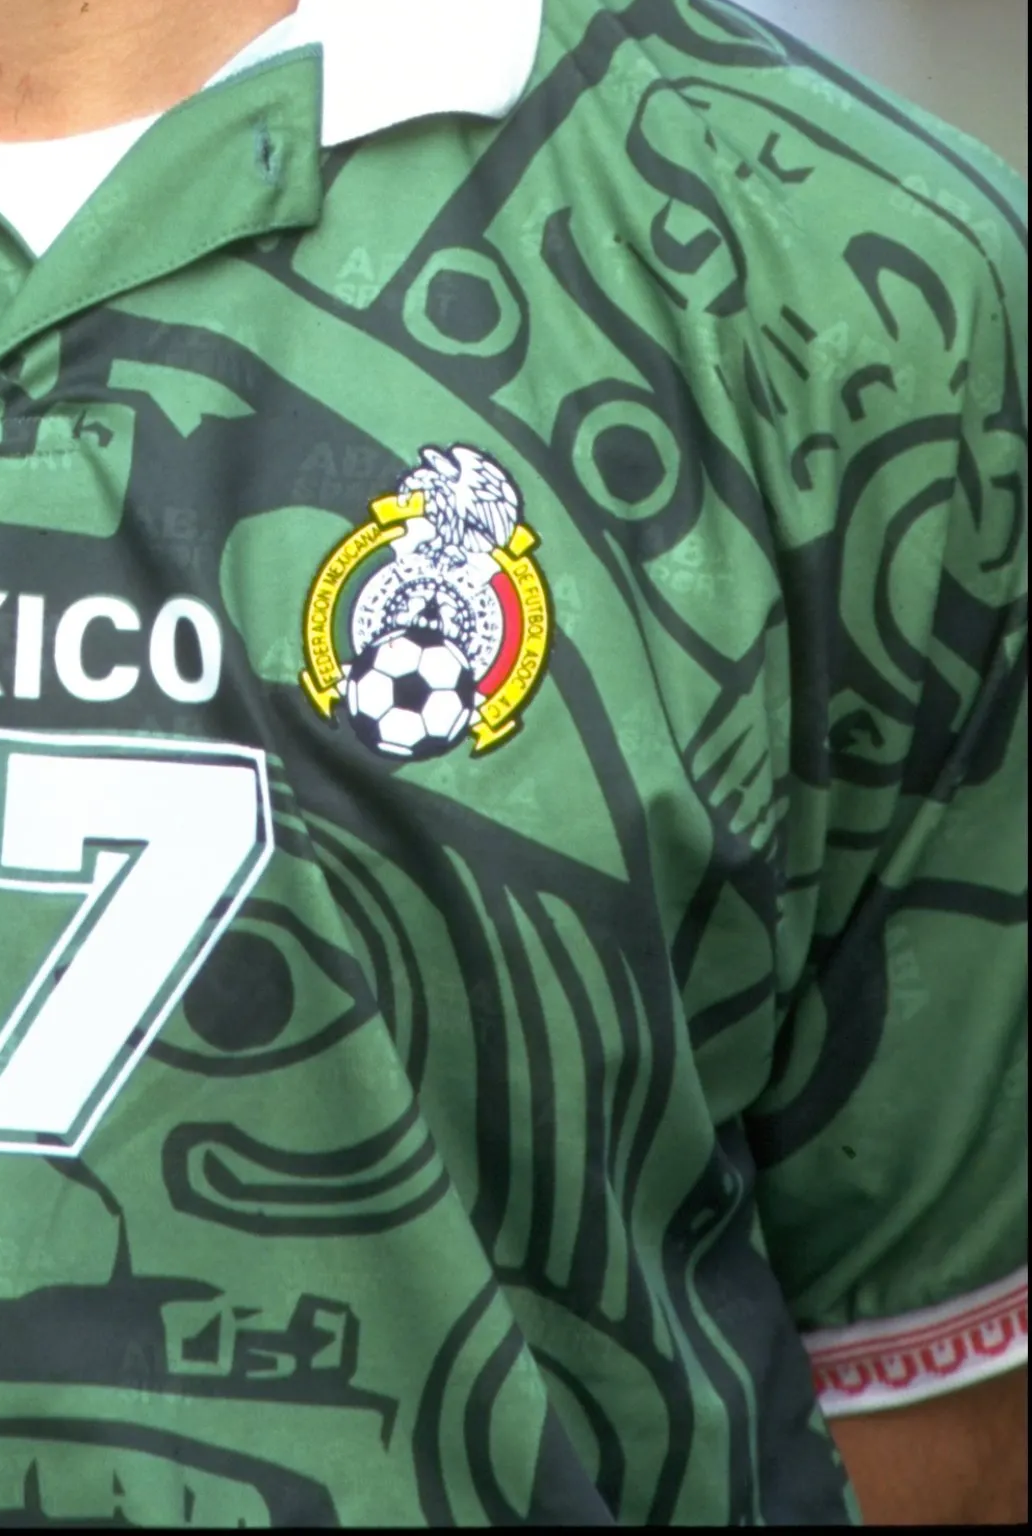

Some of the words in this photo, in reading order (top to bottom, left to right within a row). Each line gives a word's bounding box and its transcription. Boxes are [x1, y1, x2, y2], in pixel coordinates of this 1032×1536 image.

[311, 586, 334, 685] FEDERACION
[513, 564, 534, 585] DE
[525, 586, 544, 640] FUTBOL
